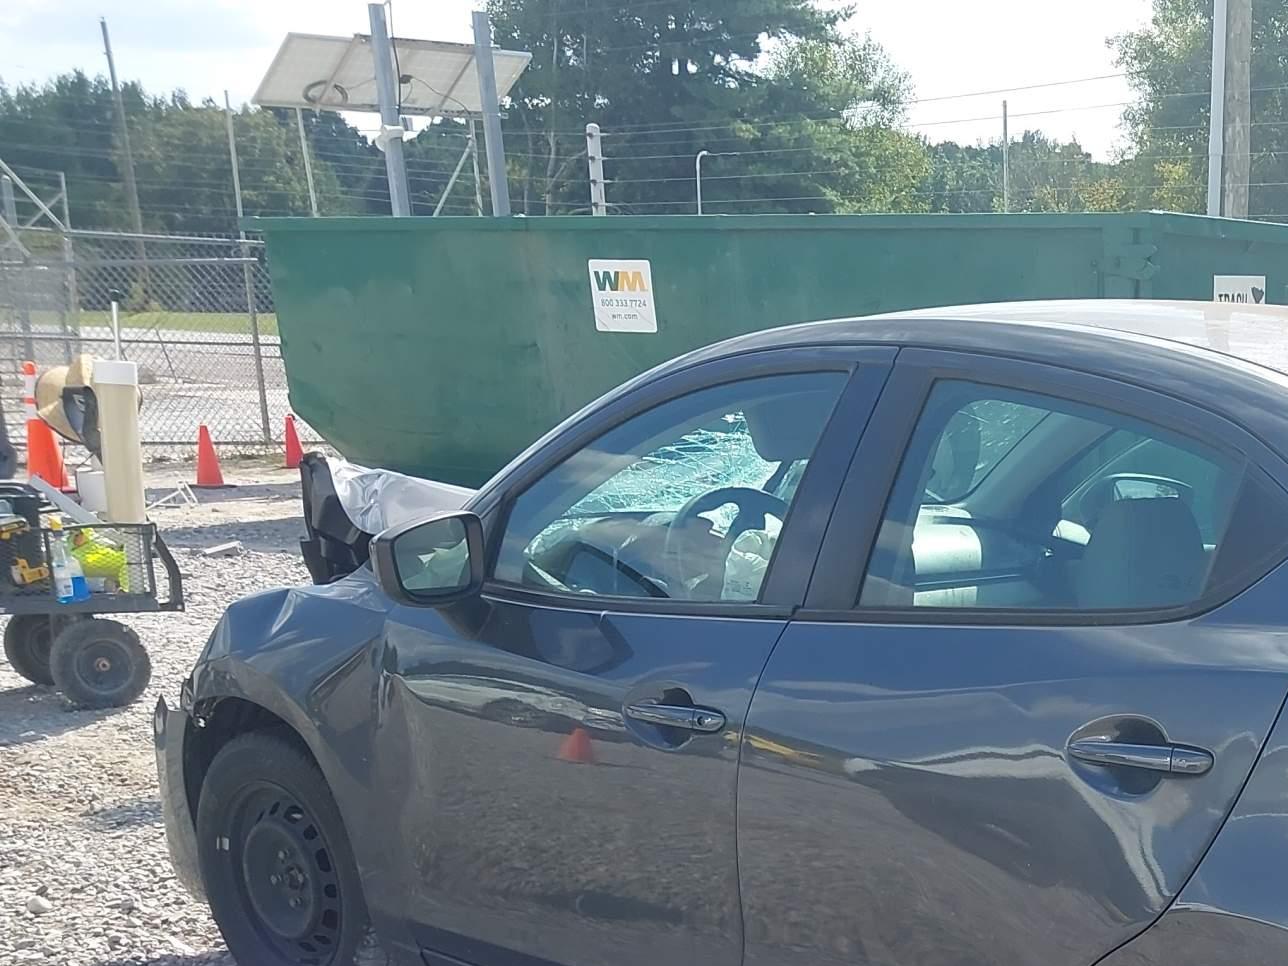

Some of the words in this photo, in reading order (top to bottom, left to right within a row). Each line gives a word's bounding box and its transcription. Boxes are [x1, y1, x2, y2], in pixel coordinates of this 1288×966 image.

[593, 271, 648, 291] WM
[601, 299, 614, 307] 800
[615, 299, 628, 307] 333
[629, 299, 647, 307] 7724
